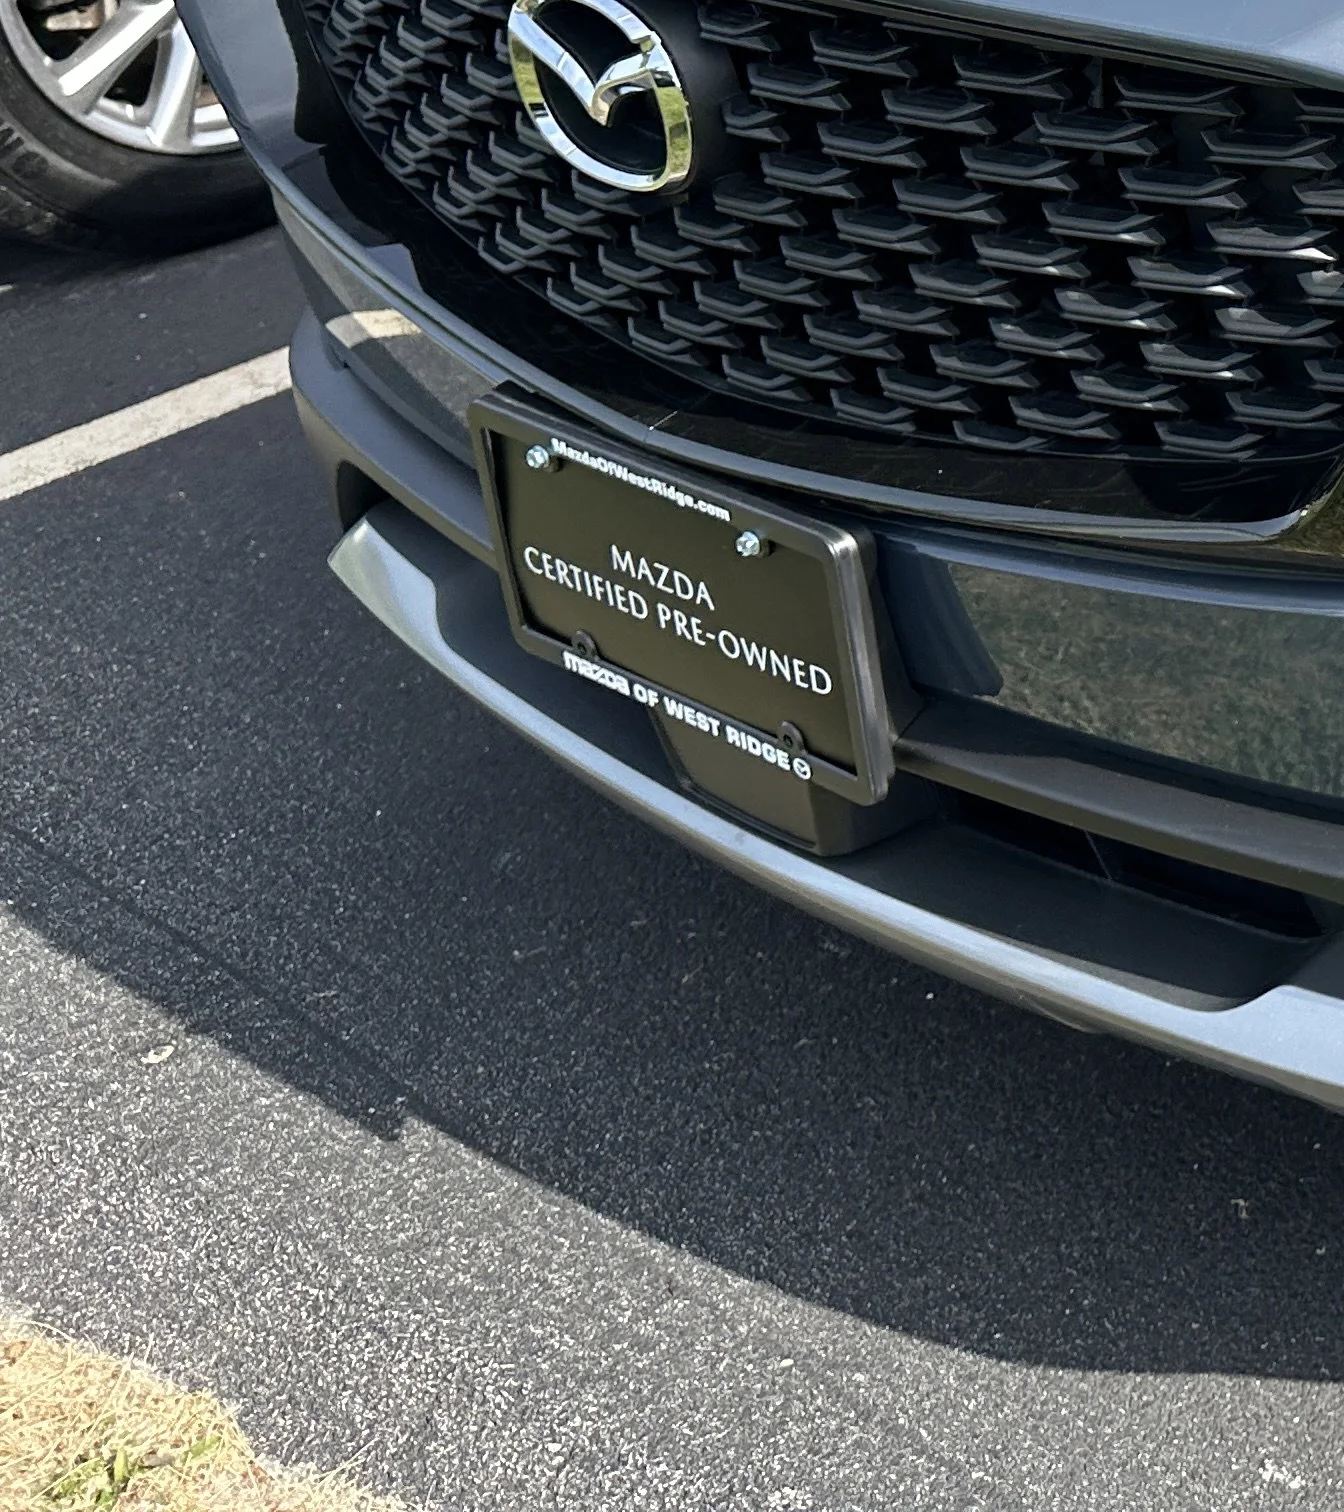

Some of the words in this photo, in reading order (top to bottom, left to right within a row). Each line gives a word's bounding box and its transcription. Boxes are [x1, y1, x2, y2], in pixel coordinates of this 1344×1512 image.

[550, 437, 731, 522] MazdaOfWestRidge.com
[523, 545, 648, 620] CERTIFIED
[656, 602, 833, 695] PRE-OWNED
[610, 544, 715, 611] MAZDA
[633, 685, 659, 709] OF
[663, 695, 720, 738] WEST
[725, 724, 792, 770] RIDGE
